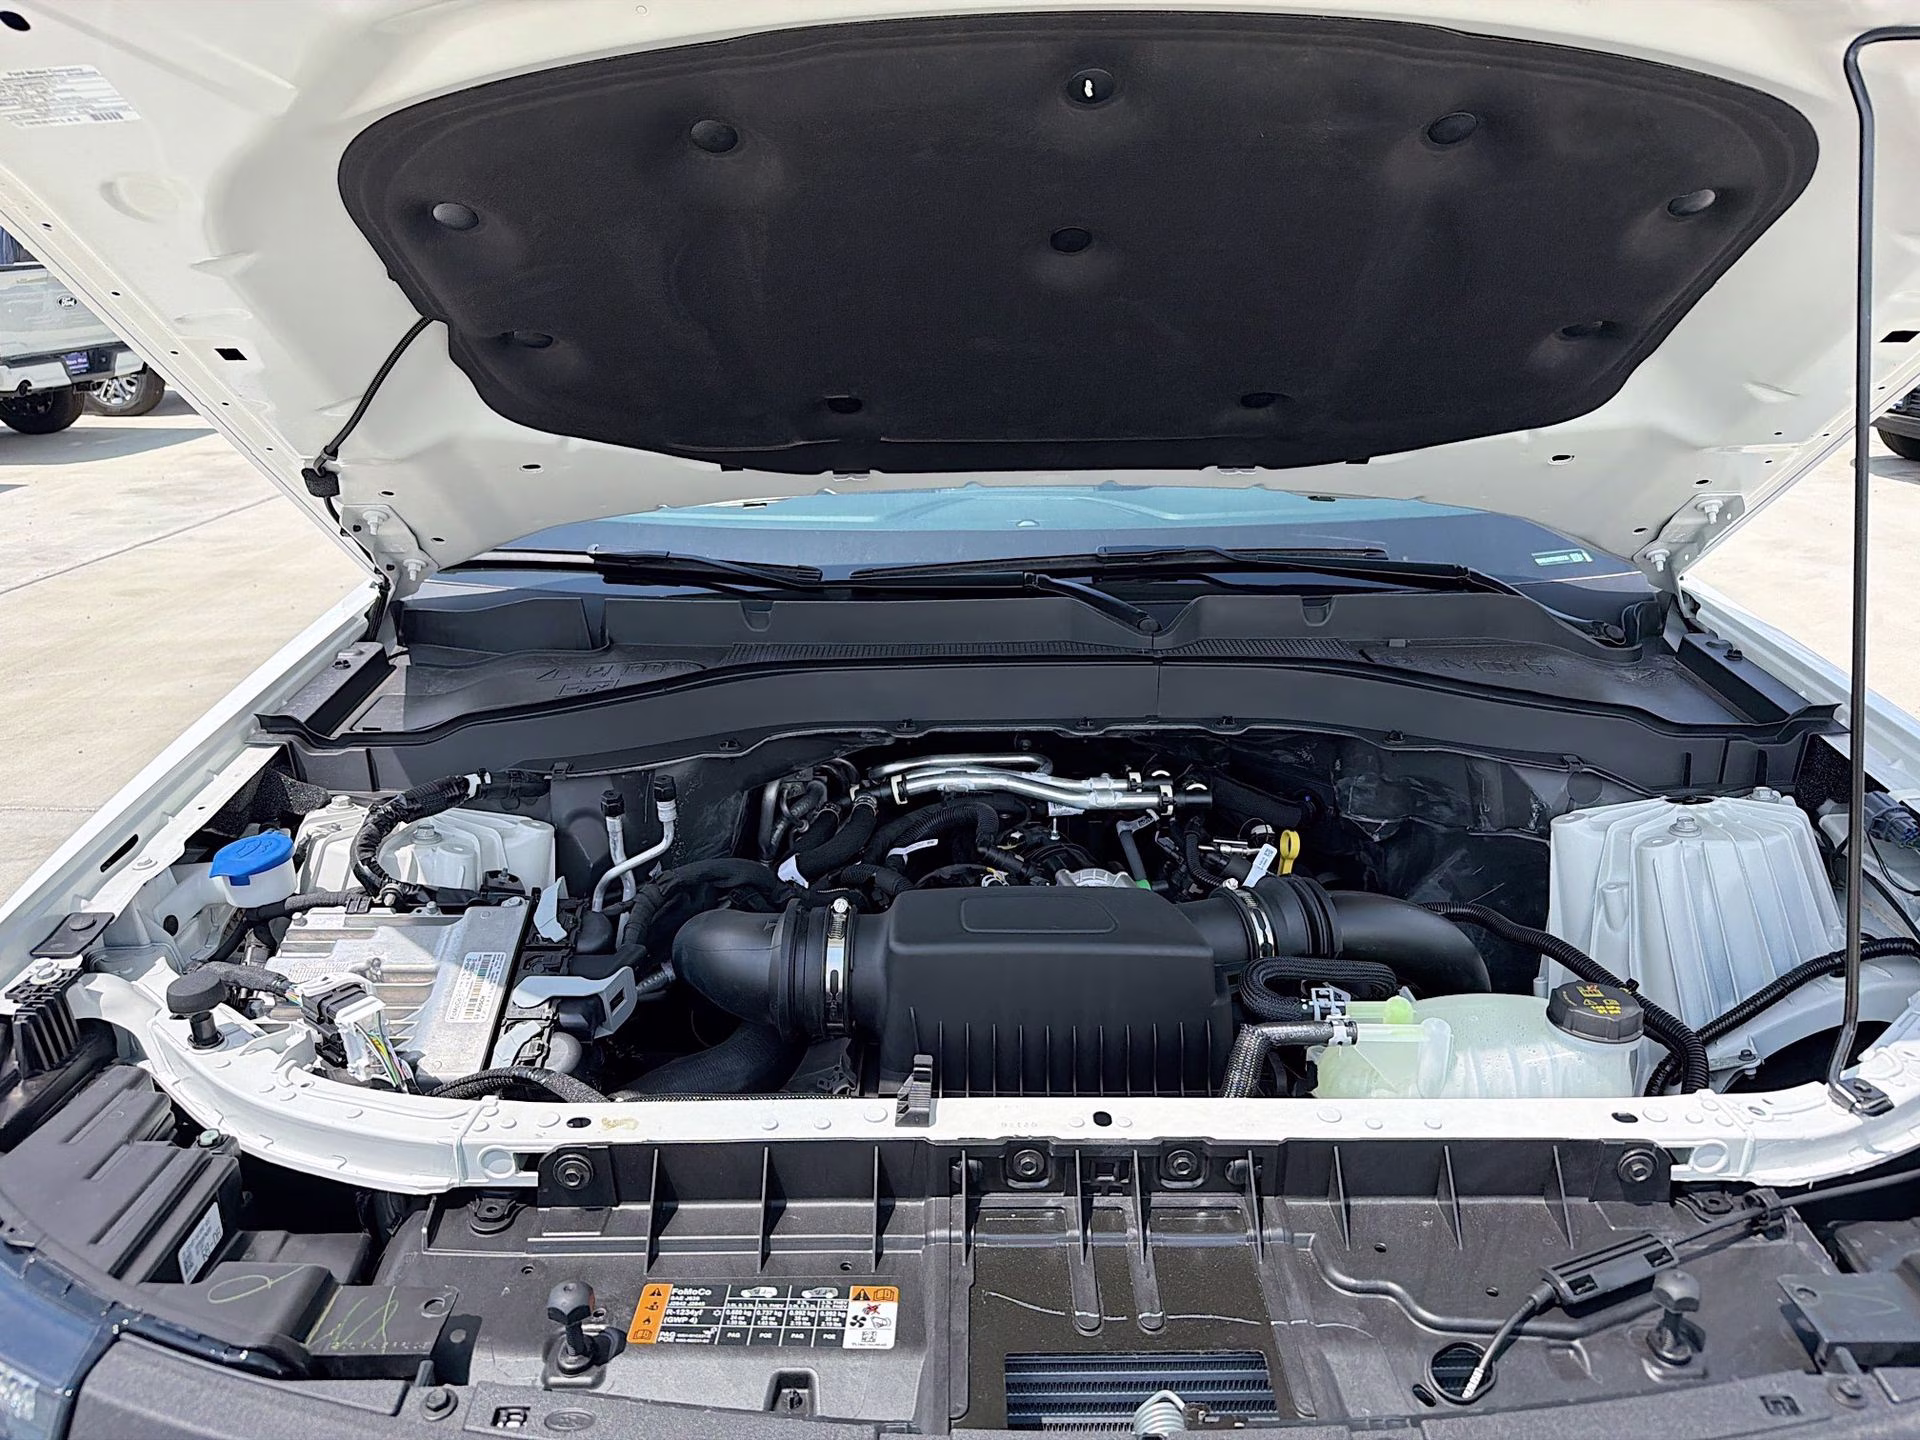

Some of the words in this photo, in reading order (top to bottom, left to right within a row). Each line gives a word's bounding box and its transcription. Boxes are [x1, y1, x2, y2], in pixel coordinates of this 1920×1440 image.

[671, 1288, 712, 1296] FoMoCo
[665, 1309, 704, 1317] R-1234yf
[663, 1316, 689, 1324] (GWP
